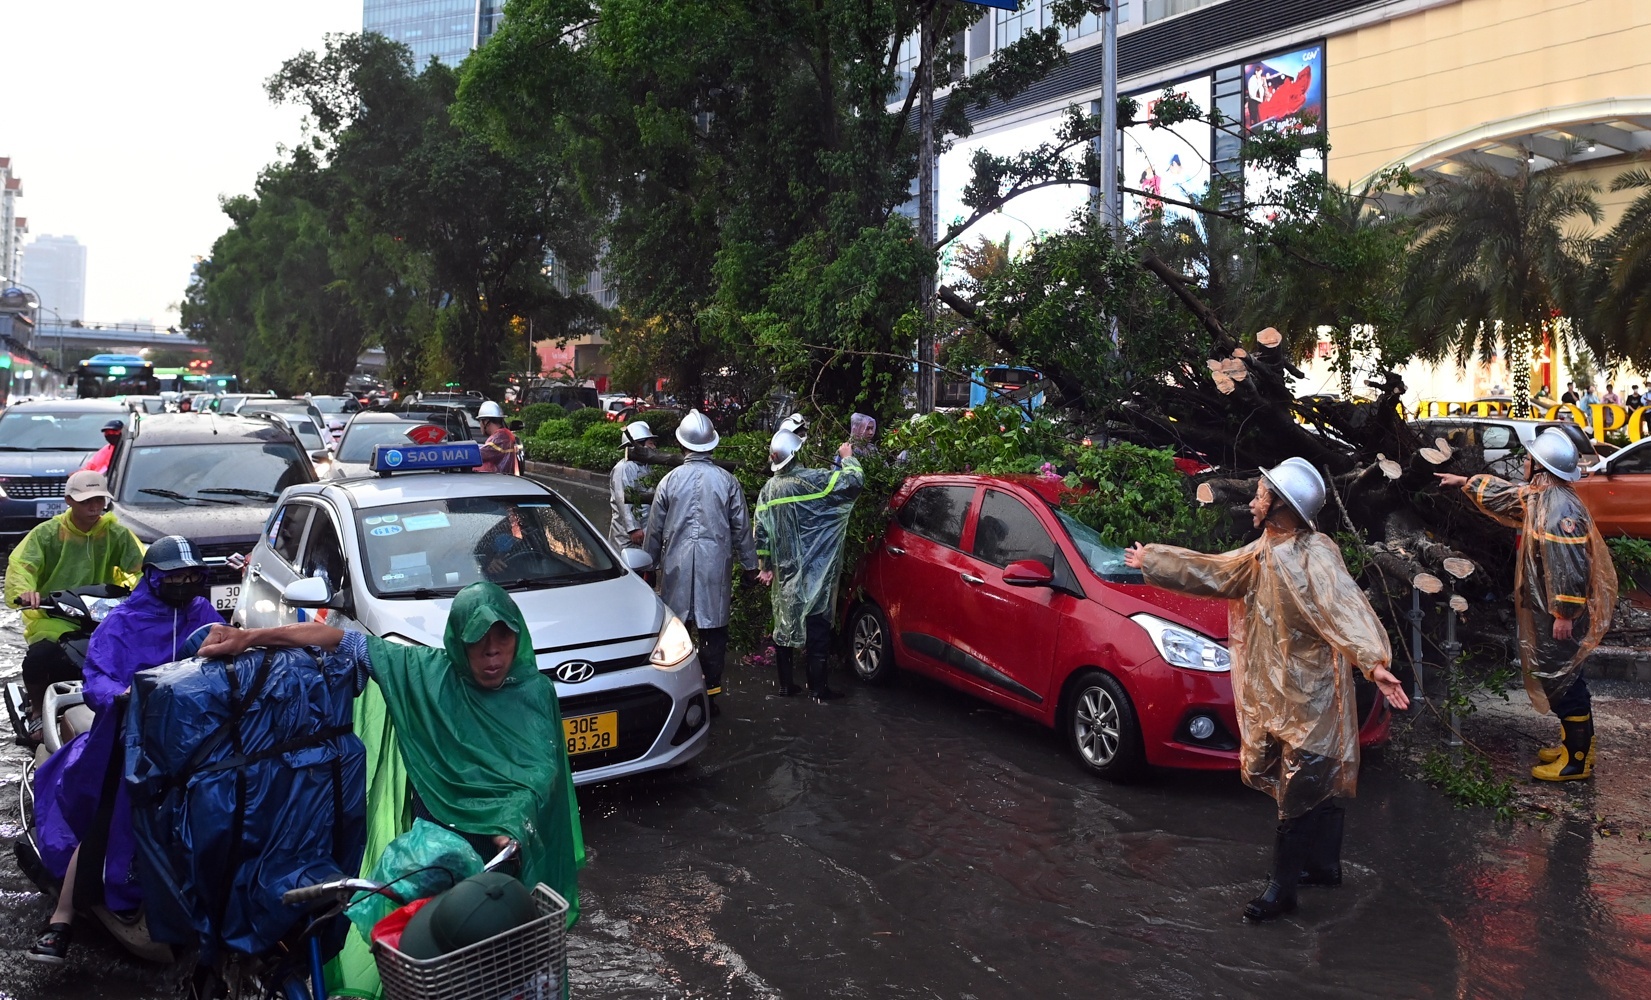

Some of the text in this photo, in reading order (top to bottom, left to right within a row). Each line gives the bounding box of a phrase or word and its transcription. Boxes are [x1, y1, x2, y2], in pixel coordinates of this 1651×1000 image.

[407, 449, 469, 463] SAO MAI
[569, 716, 599, 735] 30E
